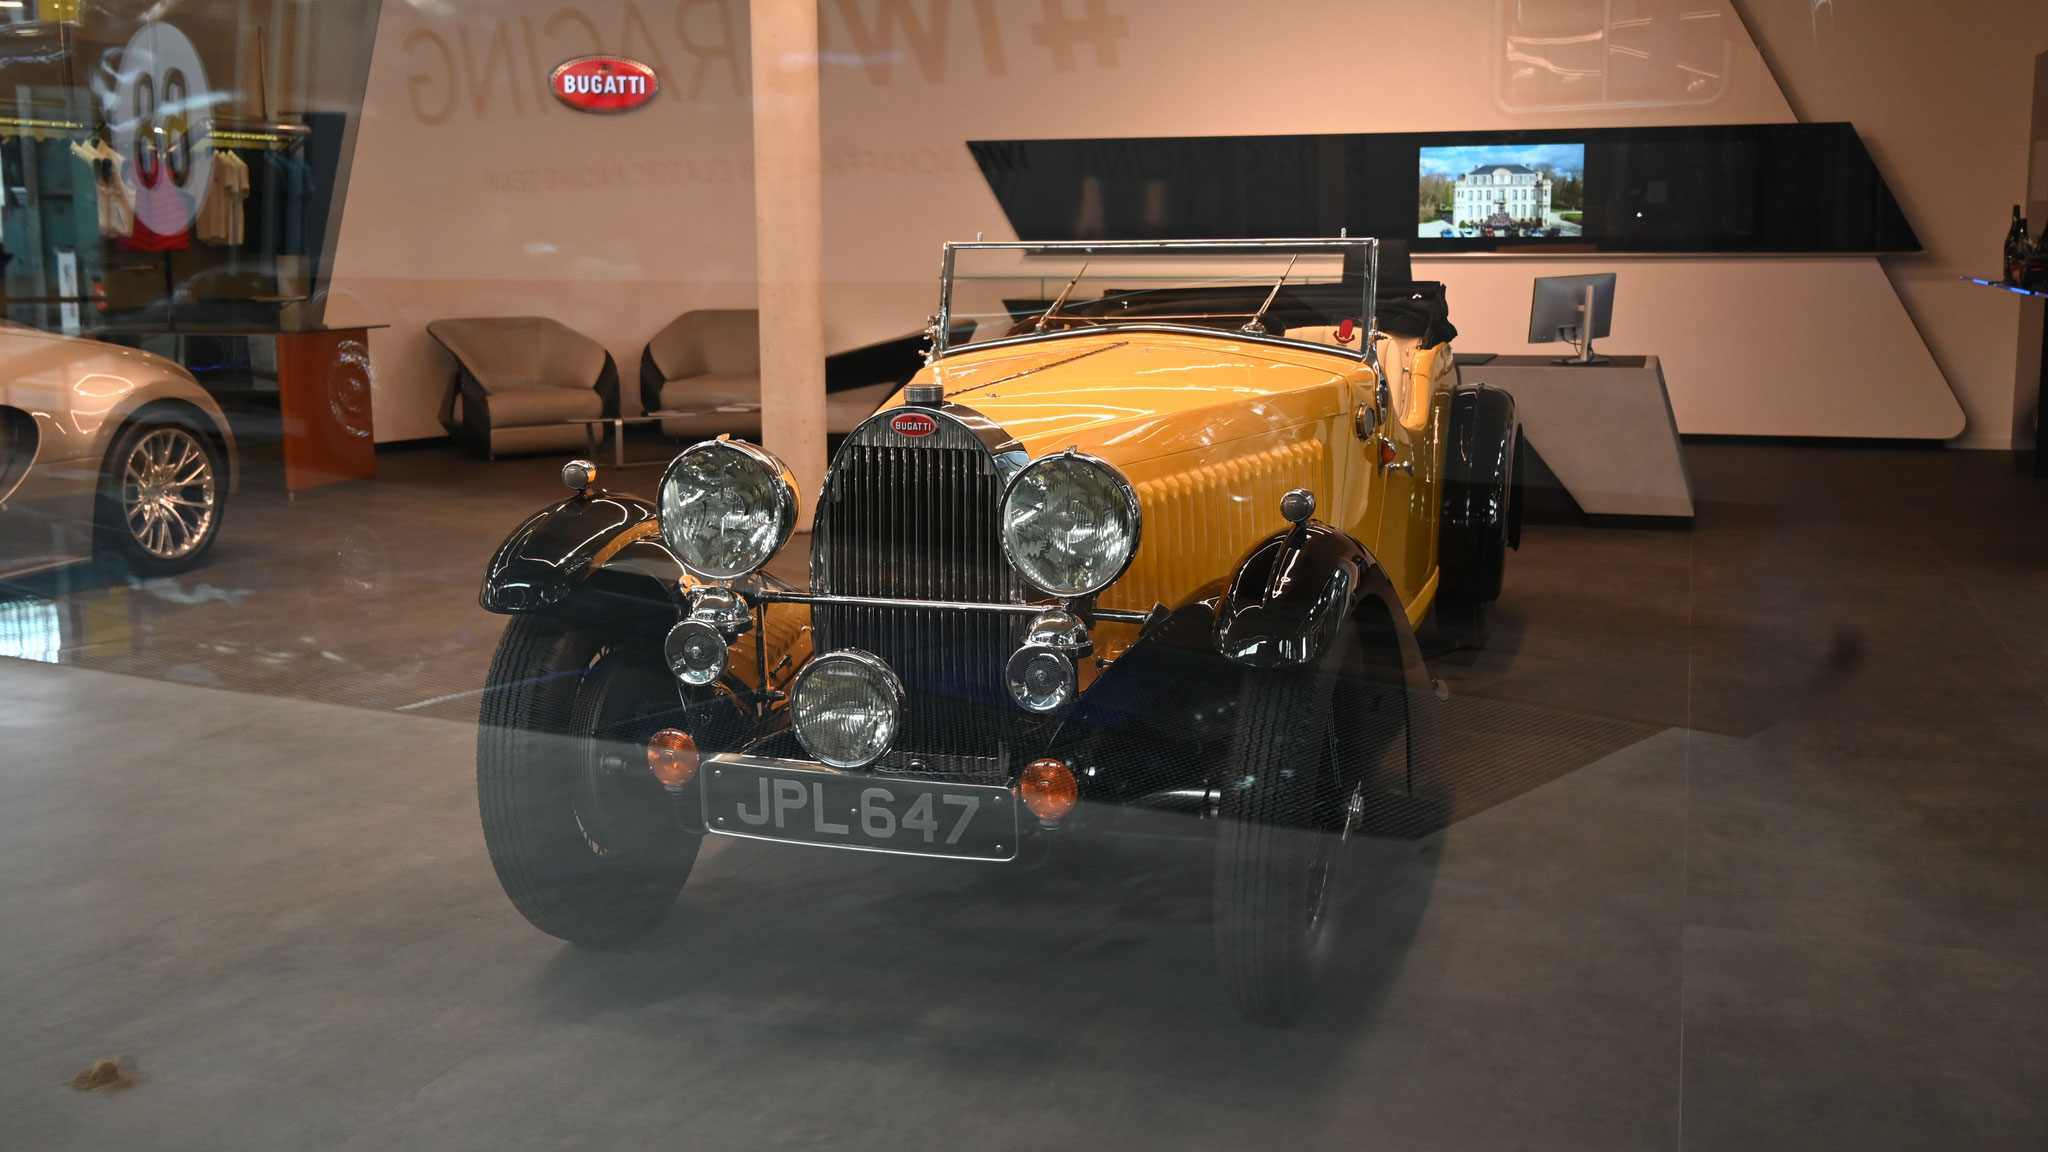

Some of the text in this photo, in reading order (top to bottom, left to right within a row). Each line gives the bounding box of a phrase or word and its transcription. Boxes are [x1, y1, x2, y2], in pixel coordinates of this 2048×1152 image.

[563, 74, 646, 95] BUGATTI
[895, 421, 932, 432] BUGATTI
[736, 776, 980, 845] JPL 647
